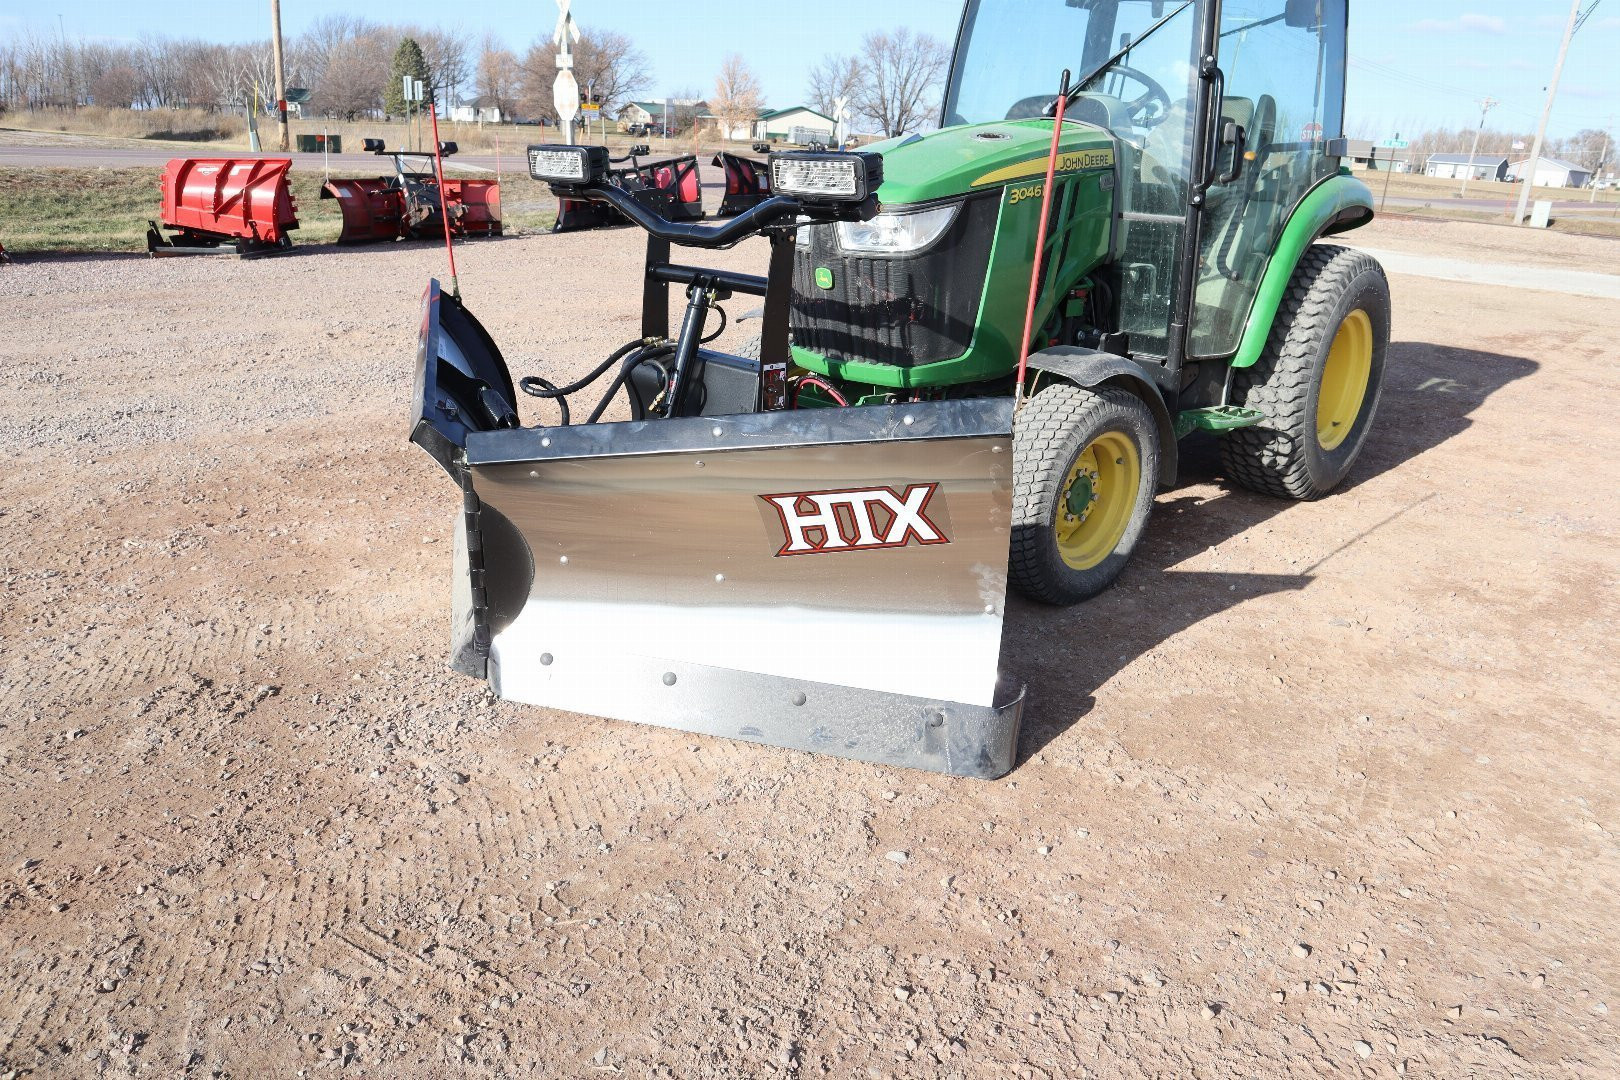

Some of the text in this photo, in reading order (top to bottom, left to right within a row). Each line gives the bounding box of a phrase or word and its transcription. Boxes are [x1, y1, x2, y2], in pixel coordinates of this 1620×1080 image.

[1060, 154, 1109, 170] JOHN DEERE
[1008, 184, 1046, 205] 3046
[759, 483, 949, 556] HTX
